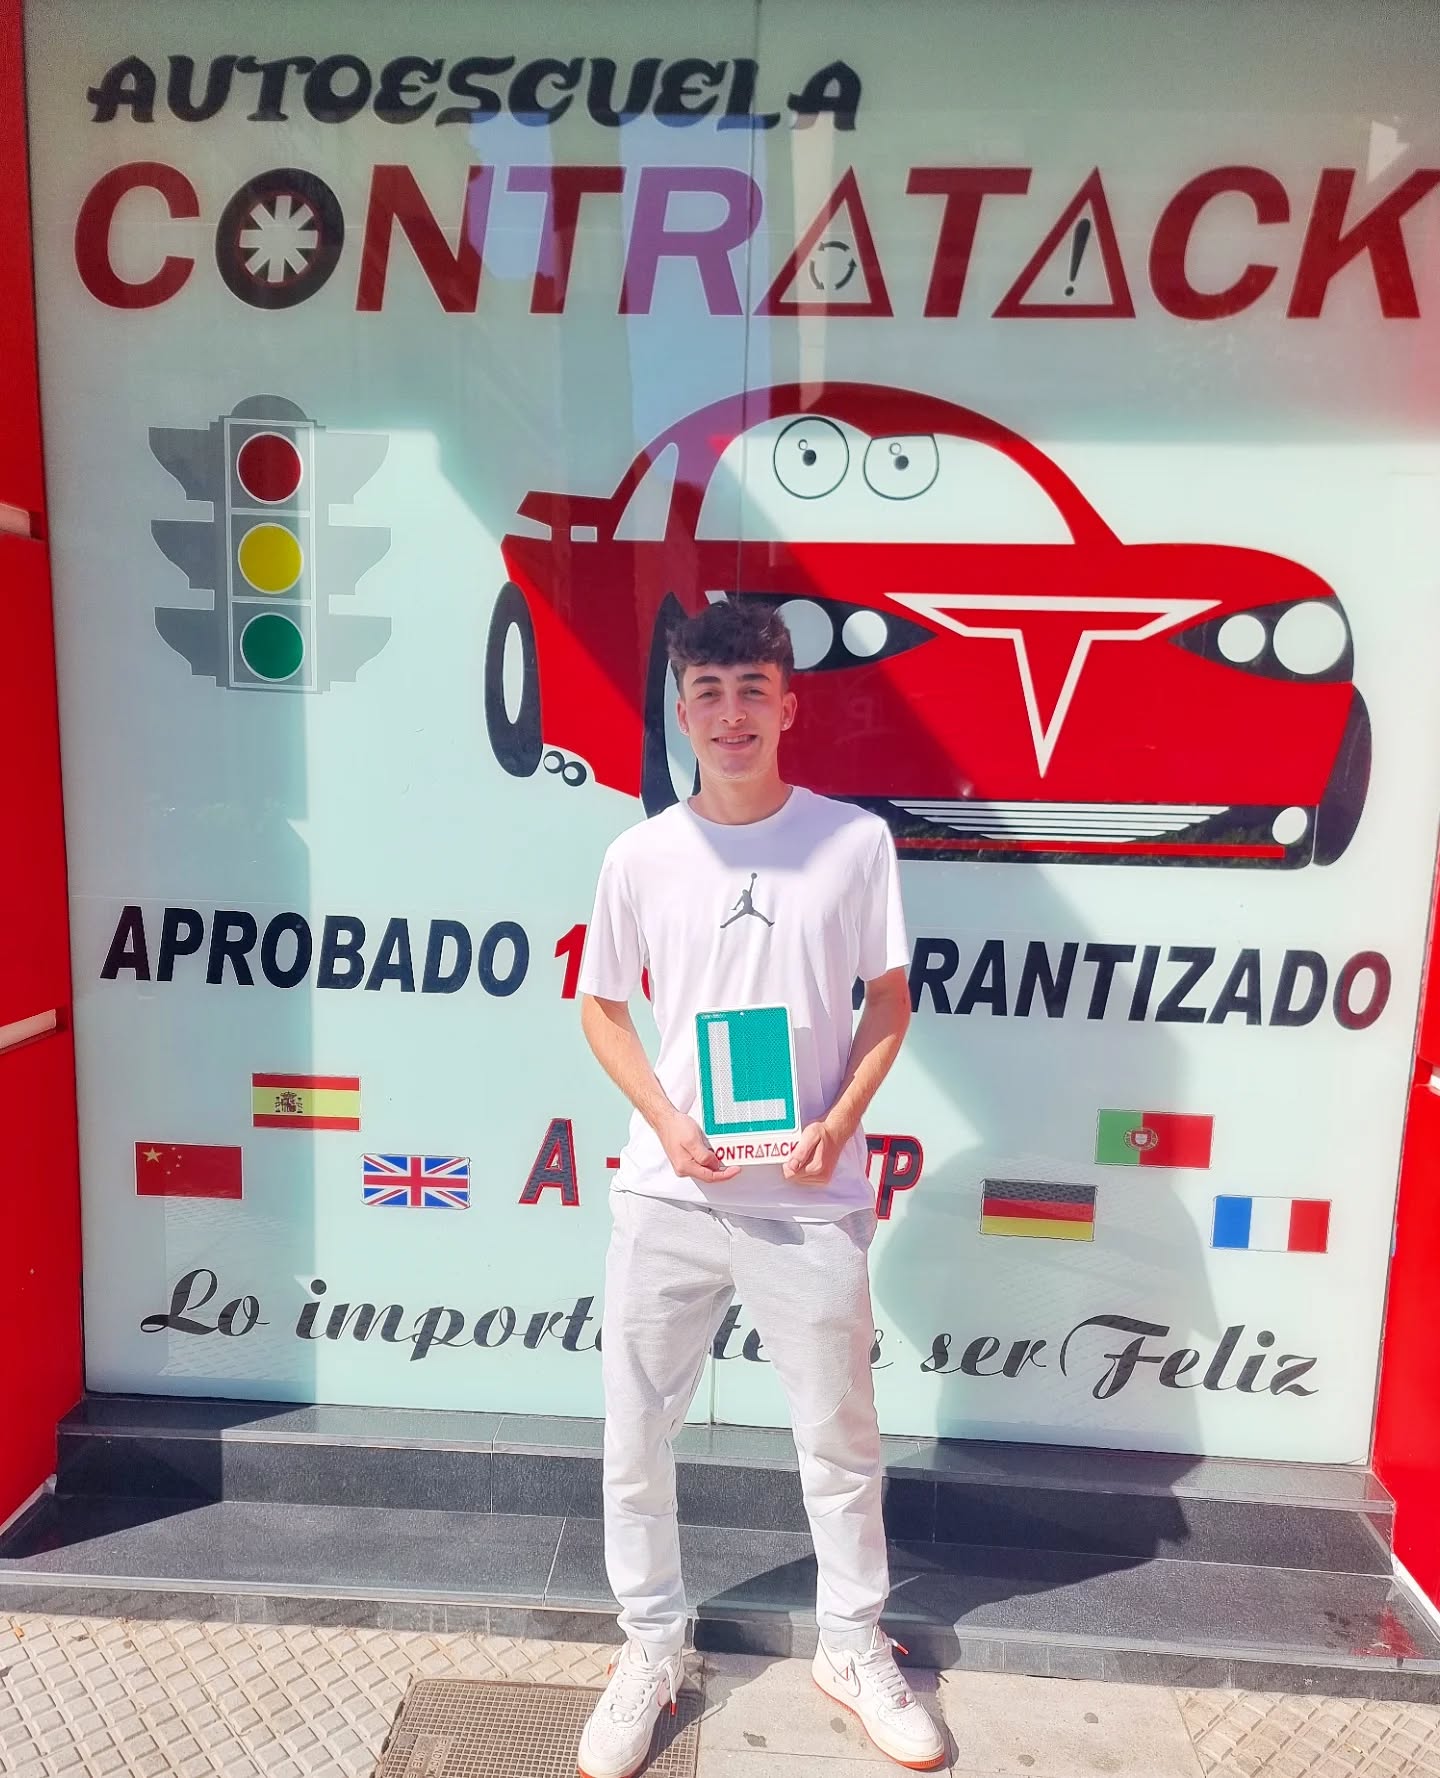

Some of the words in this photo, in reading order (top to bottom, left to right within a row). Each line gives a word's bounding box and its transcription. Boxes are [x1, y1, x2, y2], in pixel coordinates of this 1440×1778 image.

[86, 53, 863, 131] AUTOESCUELA
[74, 160, 1440, 321] CONTRATACK
[100, 905, 530, 998] APROBADO
[851, 937, 1391, 1031] RANTIZADO
[707, 1021, 788, 1125] L
[518, 1117, 580, 1206] A
[708, 1141, 800, 1161] ONTRATACK
[140, 1268, 270, 1337] Lo
[920, 1333, 1047, 1379] ser
[1059, 1314, 1319, 1400] Feliz
